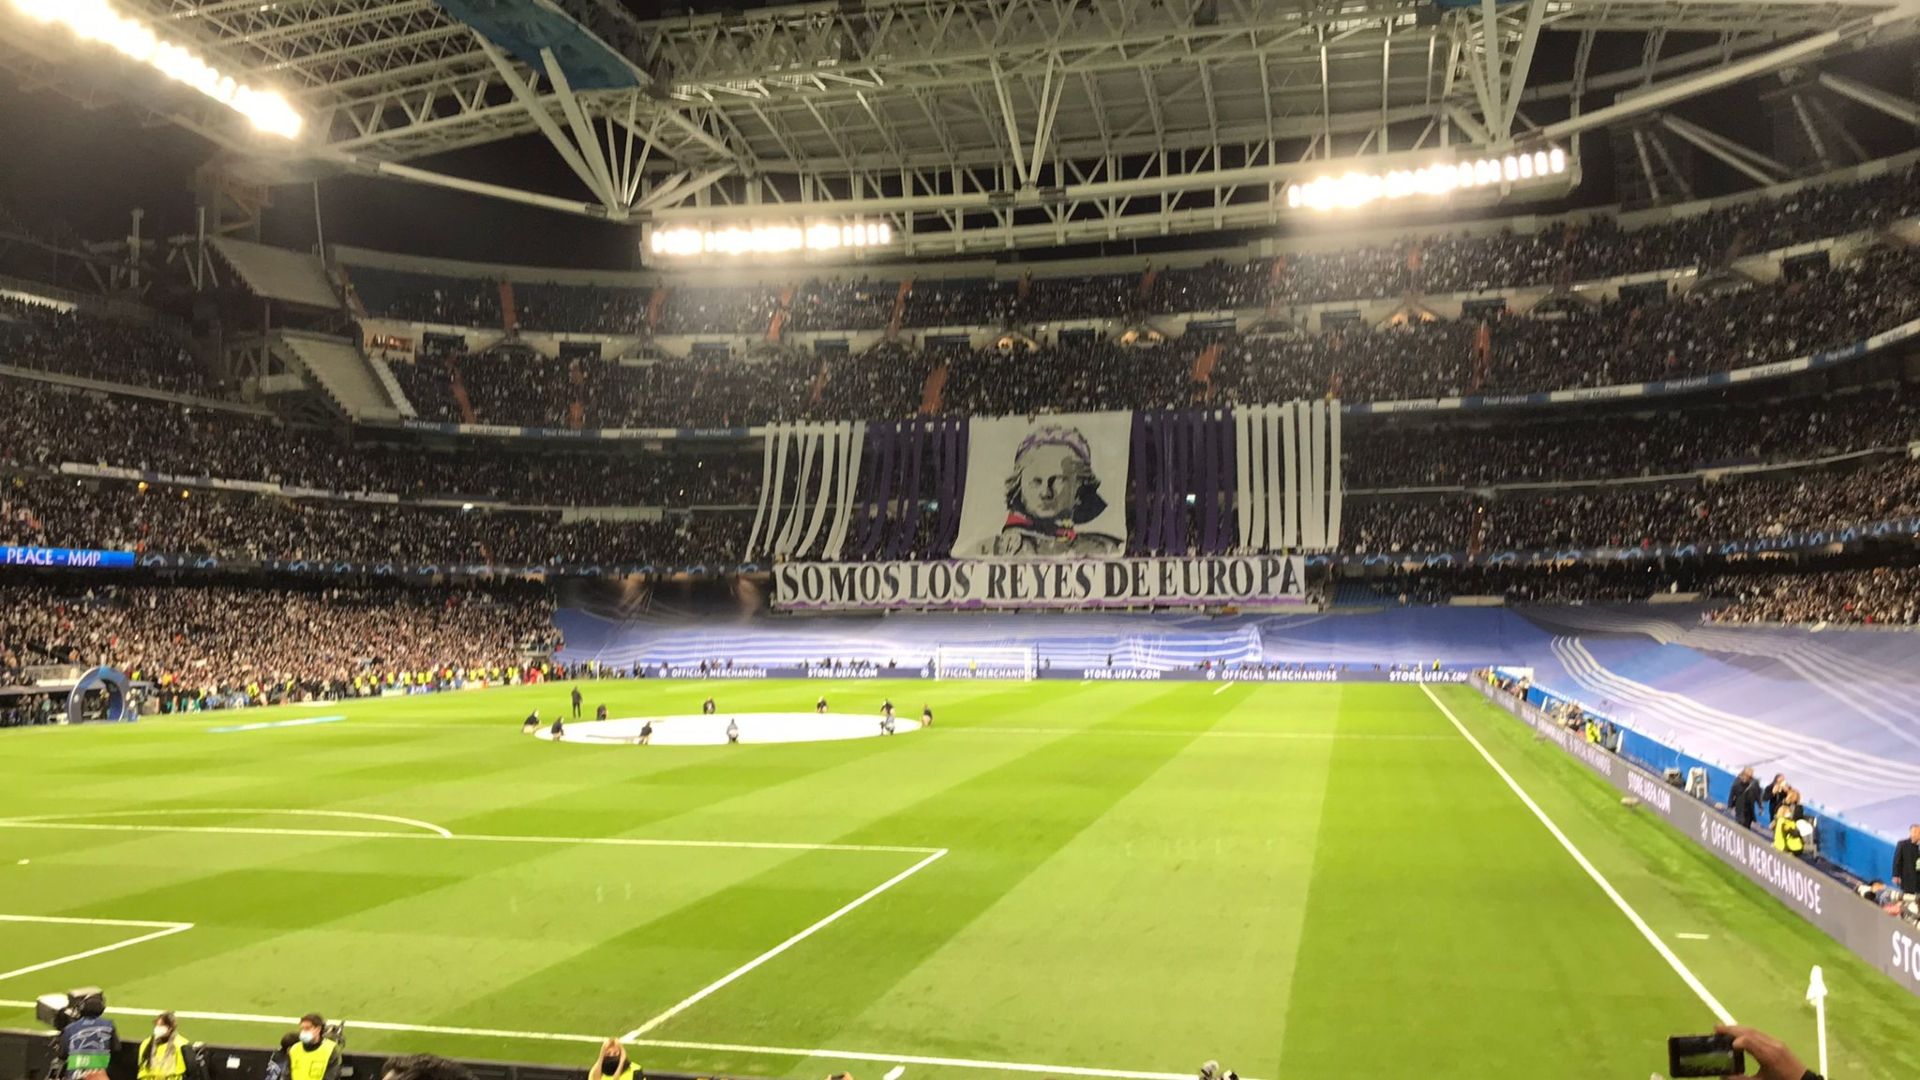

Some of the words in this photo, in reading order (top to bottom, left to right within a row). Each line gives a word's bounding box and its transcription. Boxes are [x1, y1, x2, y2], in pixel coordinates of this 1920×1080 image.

[7, 548, 53, 566] PEACE
[67, 550, 101, 567] МИР
[782, 563, 900, 602] SOMOS
[909, 562, 973, 599] LOS
[987, 560, 1095, 599] REYES
[1104, 559, 1150, 598] DE
[1159, 556, 1300, 598] EUROPA
[709, 668, 767, 678] MERCHANDISE
[808, 668, 878, 678] STORE.UEFA.COM
[976, 668, 1037, 678] MERCHANDE
[1084, 669, 1161, 679] STORE.UEFA.COM
[1222, 670, 1265, 680] OFFICIAL
[1267, 670, 1338, 681] MERCHANDISE
[1711, 820, 1747, 864] OFFICIAL
[1749, 843, 1822, 915] MERCHANDISE
